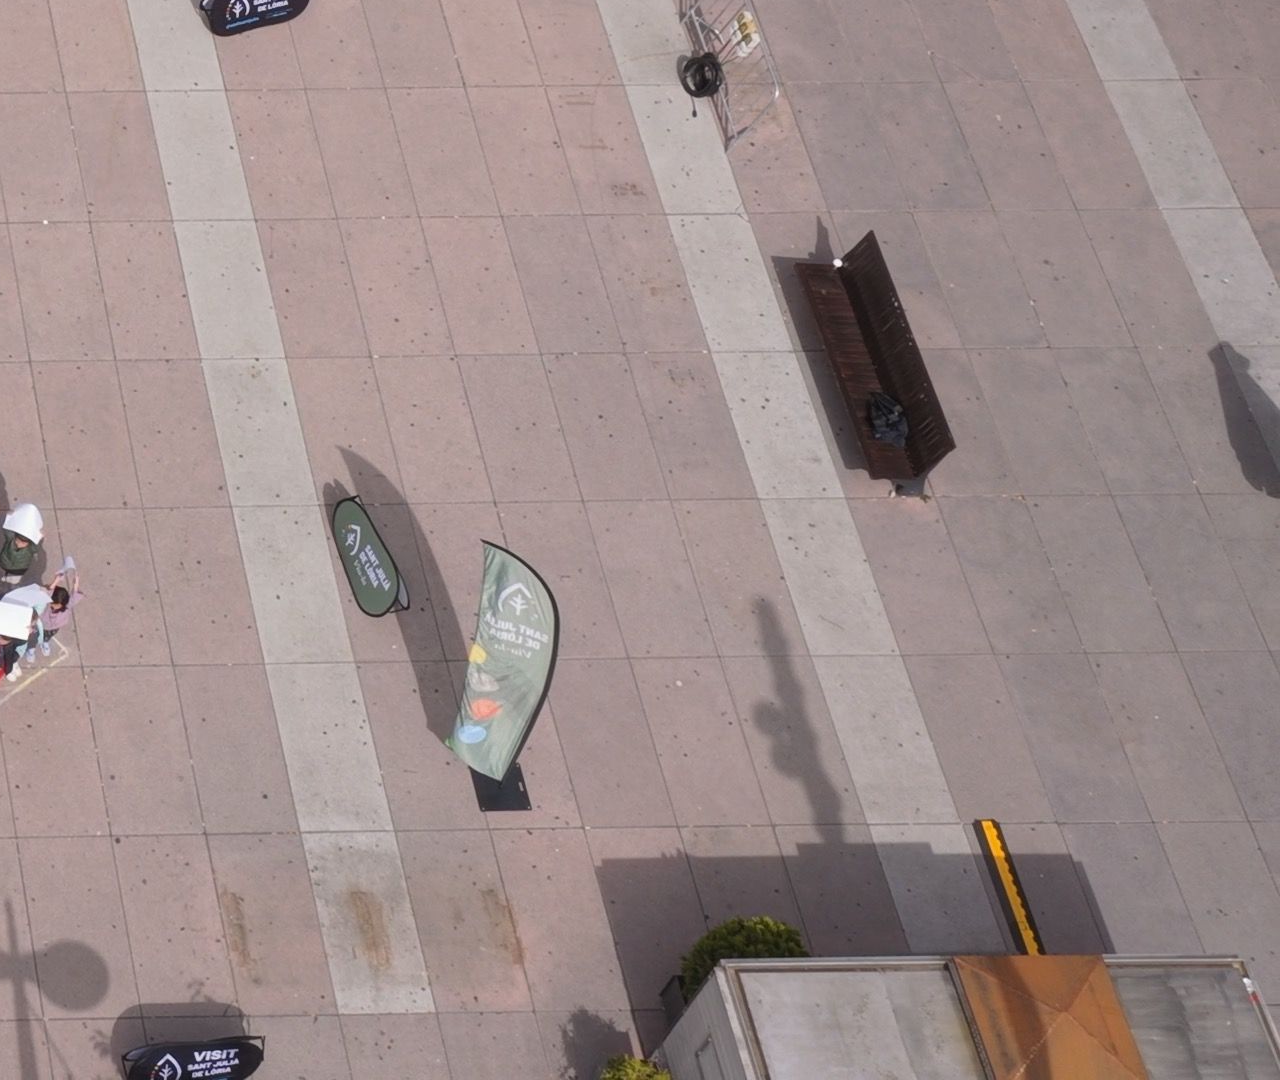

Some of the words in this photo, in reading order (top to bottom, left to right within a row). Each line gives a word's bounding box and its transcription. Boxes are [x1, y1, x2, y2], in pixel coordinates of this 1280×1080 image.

[257, 4, 268, 12] DE
[359, 551, 369, 565] DE
[364, 544, 380, 567] SANT
[193, 1049, 240, 1062] VISIT
[187, 1063, 211, 1072] SANT
[191, 1071, 205, 1079] DE
